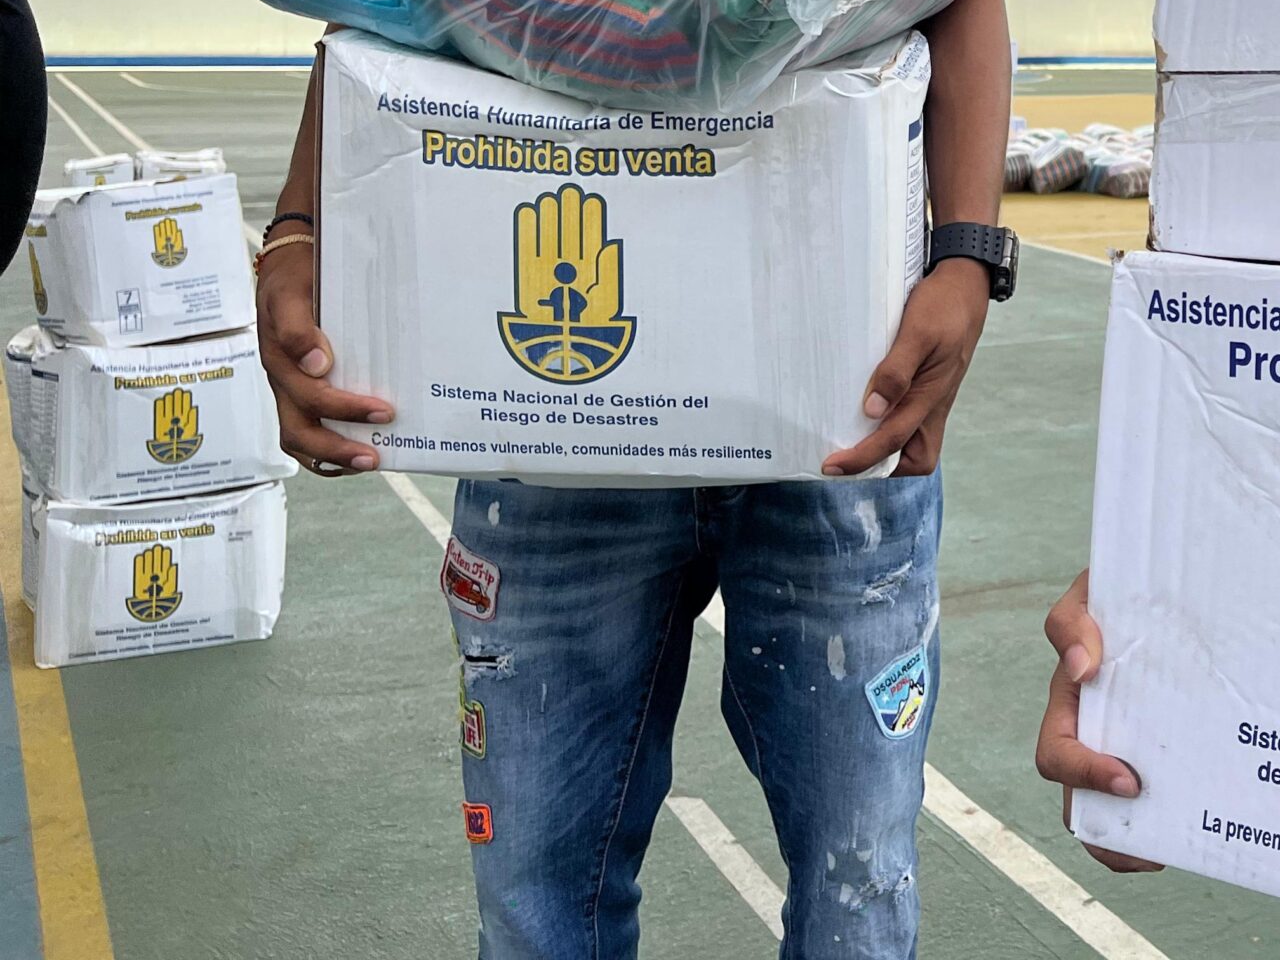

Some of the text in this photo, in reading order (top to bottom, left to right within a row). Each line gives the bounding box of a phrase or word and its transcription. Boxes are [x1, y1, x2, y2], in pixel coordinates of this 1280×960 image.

[377, 92, 774, 136] Asistencia Humanitaria de Emergencia
[423, 129, 716, 176] Prohibida su venta
[138, 360, 189, 373] Humanitaria
[205, 349, 256, 367] Emergencia
[115, 366, 234, 390] Prohibida su venta
[430, 383, 709, 410] Sistema Nacional de Gestión del
[480, 407, 659, 427] Riesgo de Desastres
[371, 431, 772, 461] Colombia menos vulnerable, comunidades más resilientes
[95, 531, 158, 546] Prohibida
[160, 528, 177, 540] su
[179, 522, 215, 536] venta
[471, 562, 495, 587] Trip
[1201, 809, 1222, 835] La
